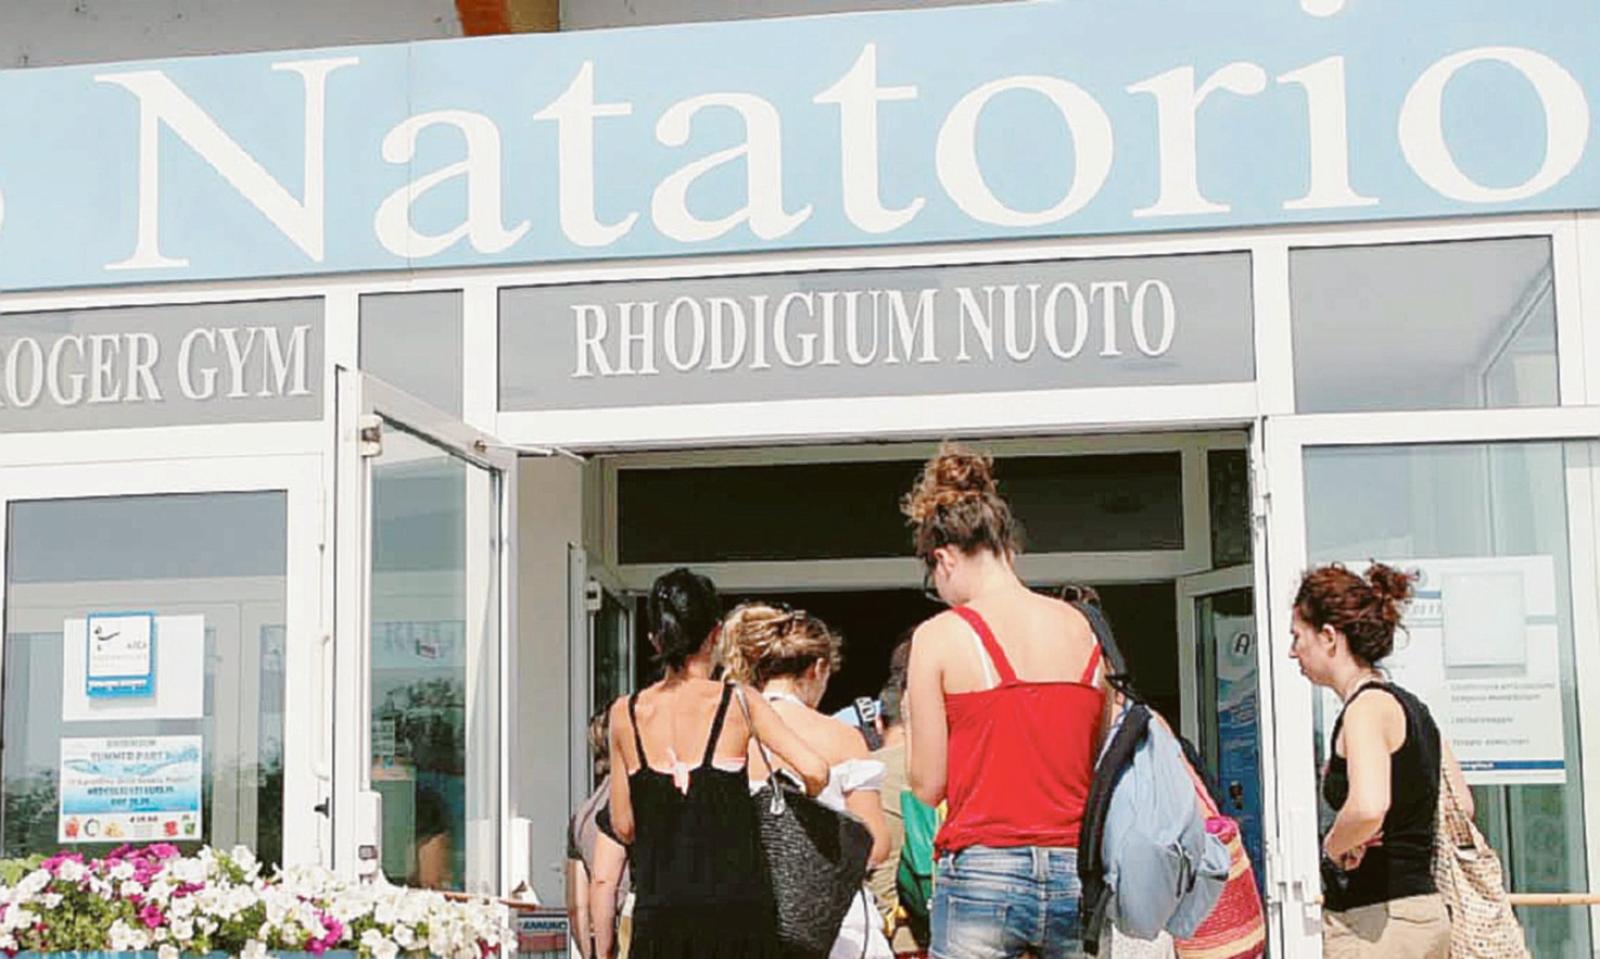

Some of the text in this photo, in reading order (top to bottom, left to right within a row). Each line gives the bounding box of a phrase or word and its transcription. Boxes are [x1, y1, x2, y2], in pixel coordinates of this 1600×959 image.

[94, 0, 1590, 271] Natatorio
[0, 324, 312, 408] OGER GYM
[570, 279, 1177, 379] RHODIGIUM NUOTO
